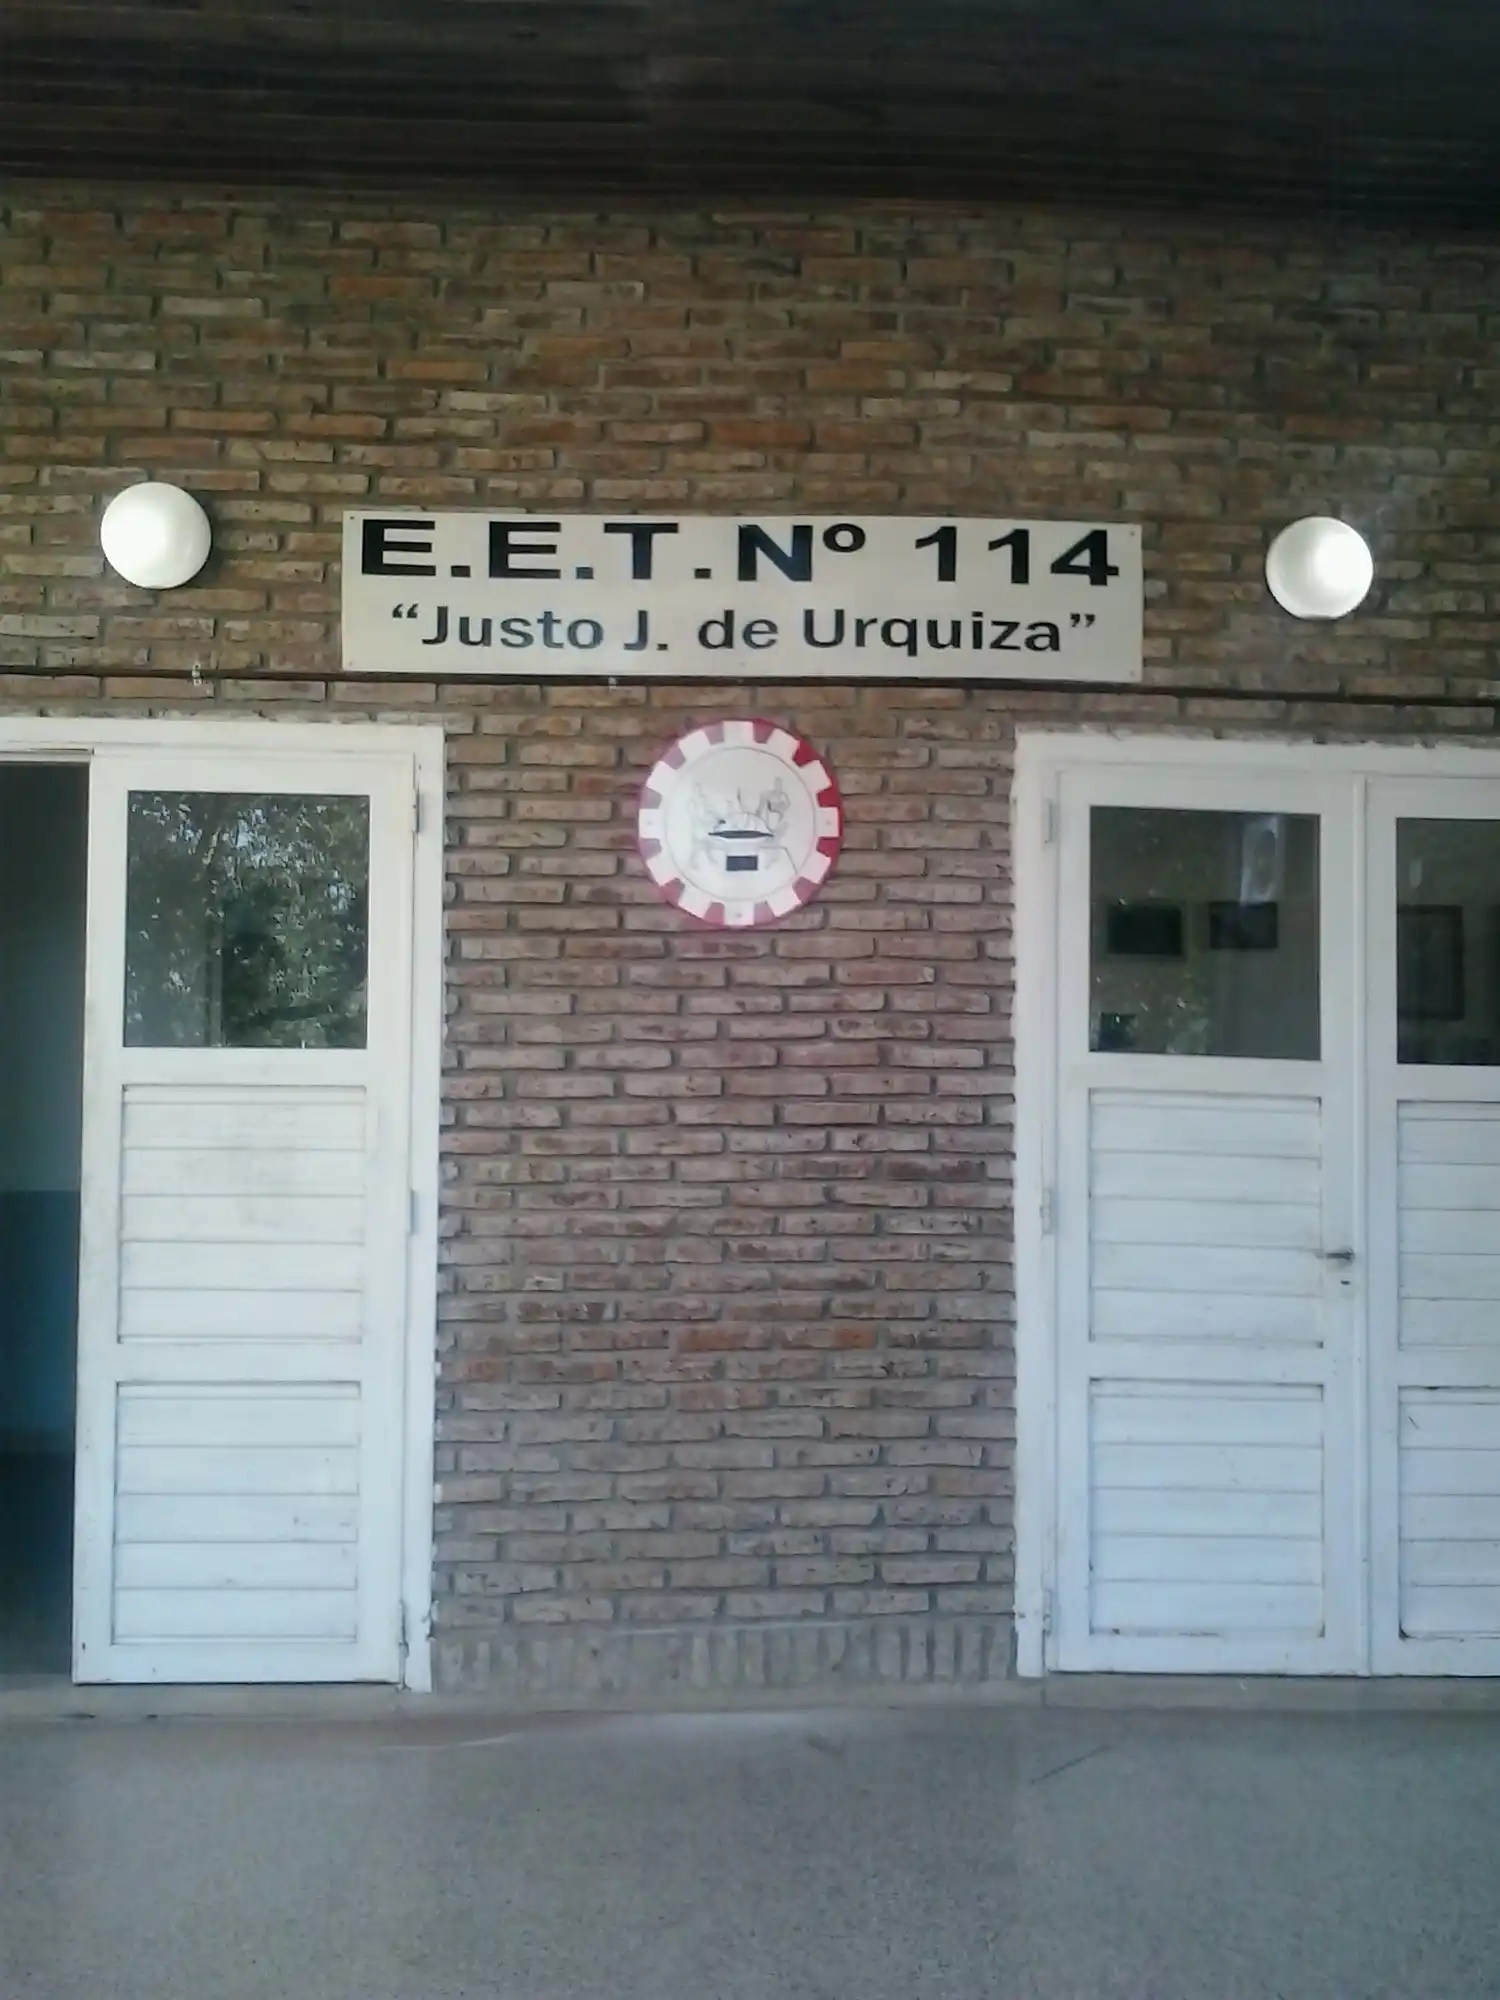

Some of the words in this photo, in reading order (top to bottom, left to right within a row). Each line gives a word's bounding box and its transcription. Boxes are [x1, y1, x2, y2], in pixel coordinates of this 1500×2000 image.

[914, 524, 1120, 587] 114
[622, 609, 670, 652] J.
[697, 609, 779, 650] de
